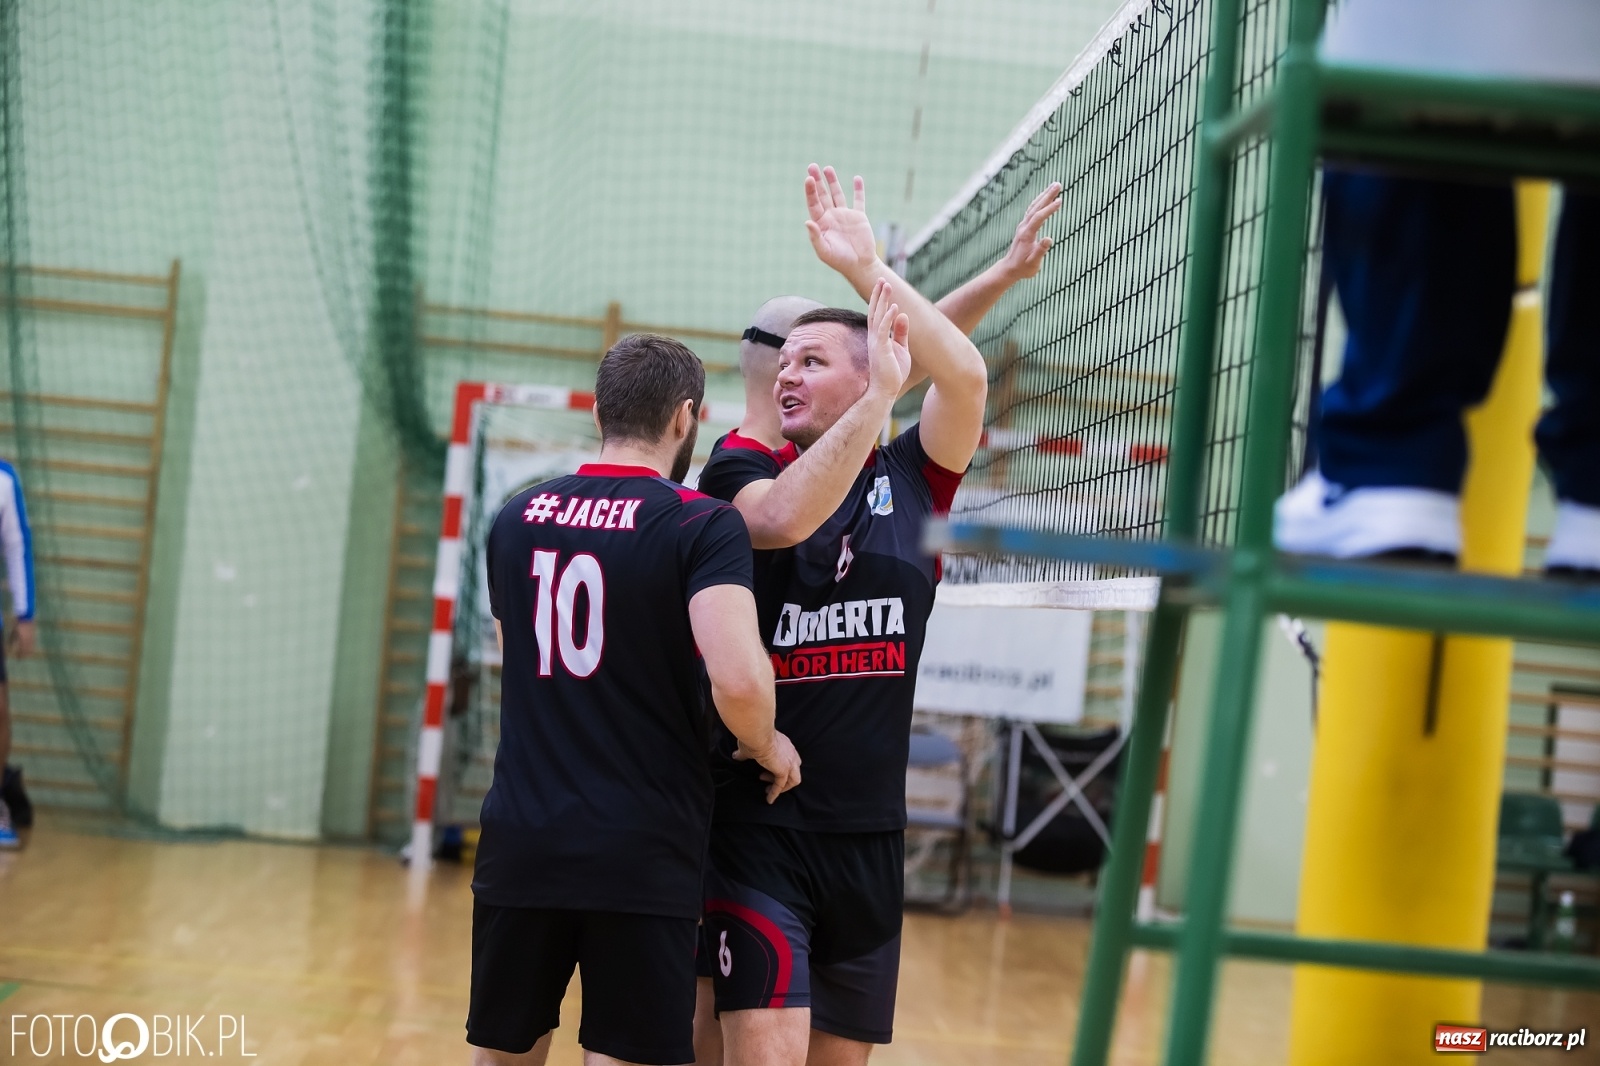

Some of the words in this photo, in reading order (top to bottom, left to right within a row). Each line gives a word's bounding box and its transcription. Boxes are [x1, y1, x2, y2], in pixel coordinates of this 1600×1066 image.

[523, 493, 643, 530] #JACEK
[530, 548, 605, 679] 10
[771, 642, 905, 678] NORTHERN
[719, 930, 732, 977] 6
